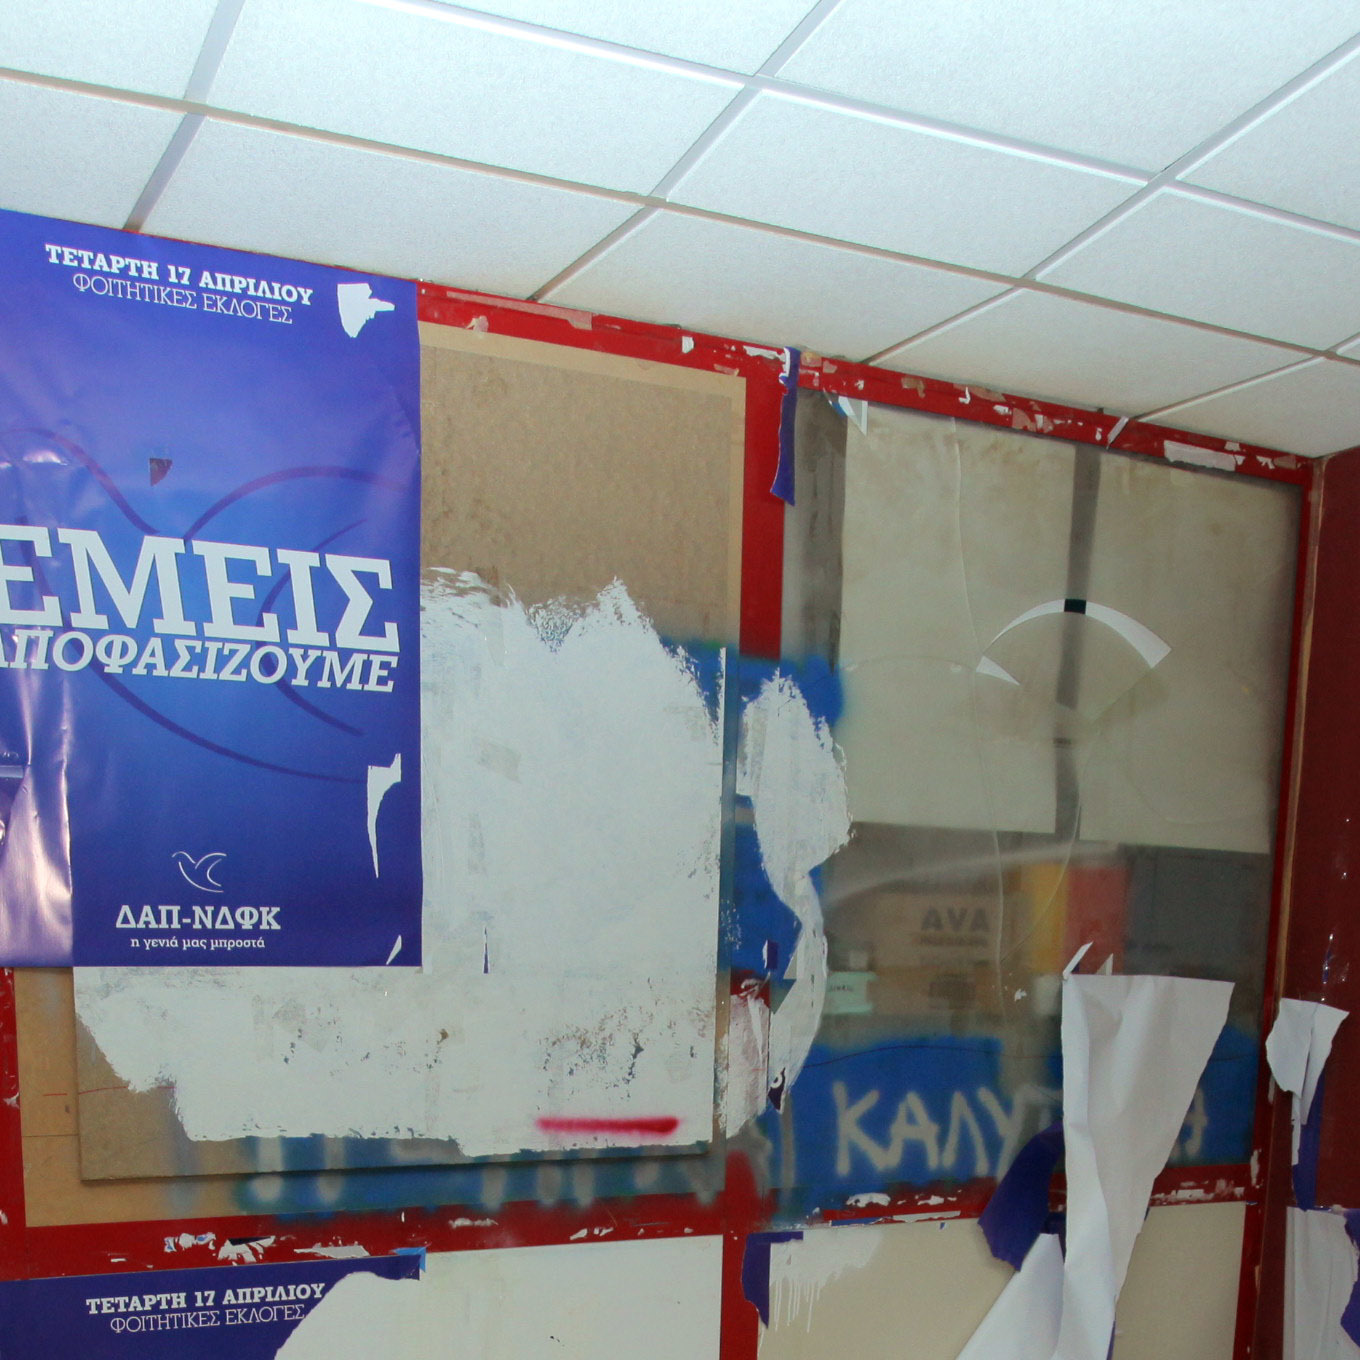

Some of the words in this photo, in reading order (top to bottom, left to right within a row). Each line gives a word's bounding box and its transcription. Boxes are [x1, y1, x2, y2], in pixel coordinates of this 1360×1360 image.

[45, 243, 159, 281] ΤΕΤΑΡΤΗ
[166, 265, 192, 284] 17
[199, 270, 314, 306] ΑΠΡΙΛΙΟΥ
[72, 273, 198, 311] ΦΟΙΤΗΤΙΚΕΣ
[203, 293, 293, 326] ΕΚΛΟΓΕΣ
[116, 905, 281, 930] ΔΑΠ-ΝΔΦΚ
[130, 937, 140, 949] η
[143, 935, 178, 951] γενιά
[182, 937, 207, 951] μας
[210, 935, 266, 951] μπροστά
[86, 1292, 187, 1315] ΤΕΤΑΡΤΗ
[194, 1290, 216, 1308] 17
[222, 1282, 326, 1305] ΑΠΡΙΛΙΟΥ
[110, 1309, 221, 1335] ΦΟΙΤΗΤΙΚΕΣ
[225, 1303, 305, 1326] ΕΚΛΟΓΕΣ
